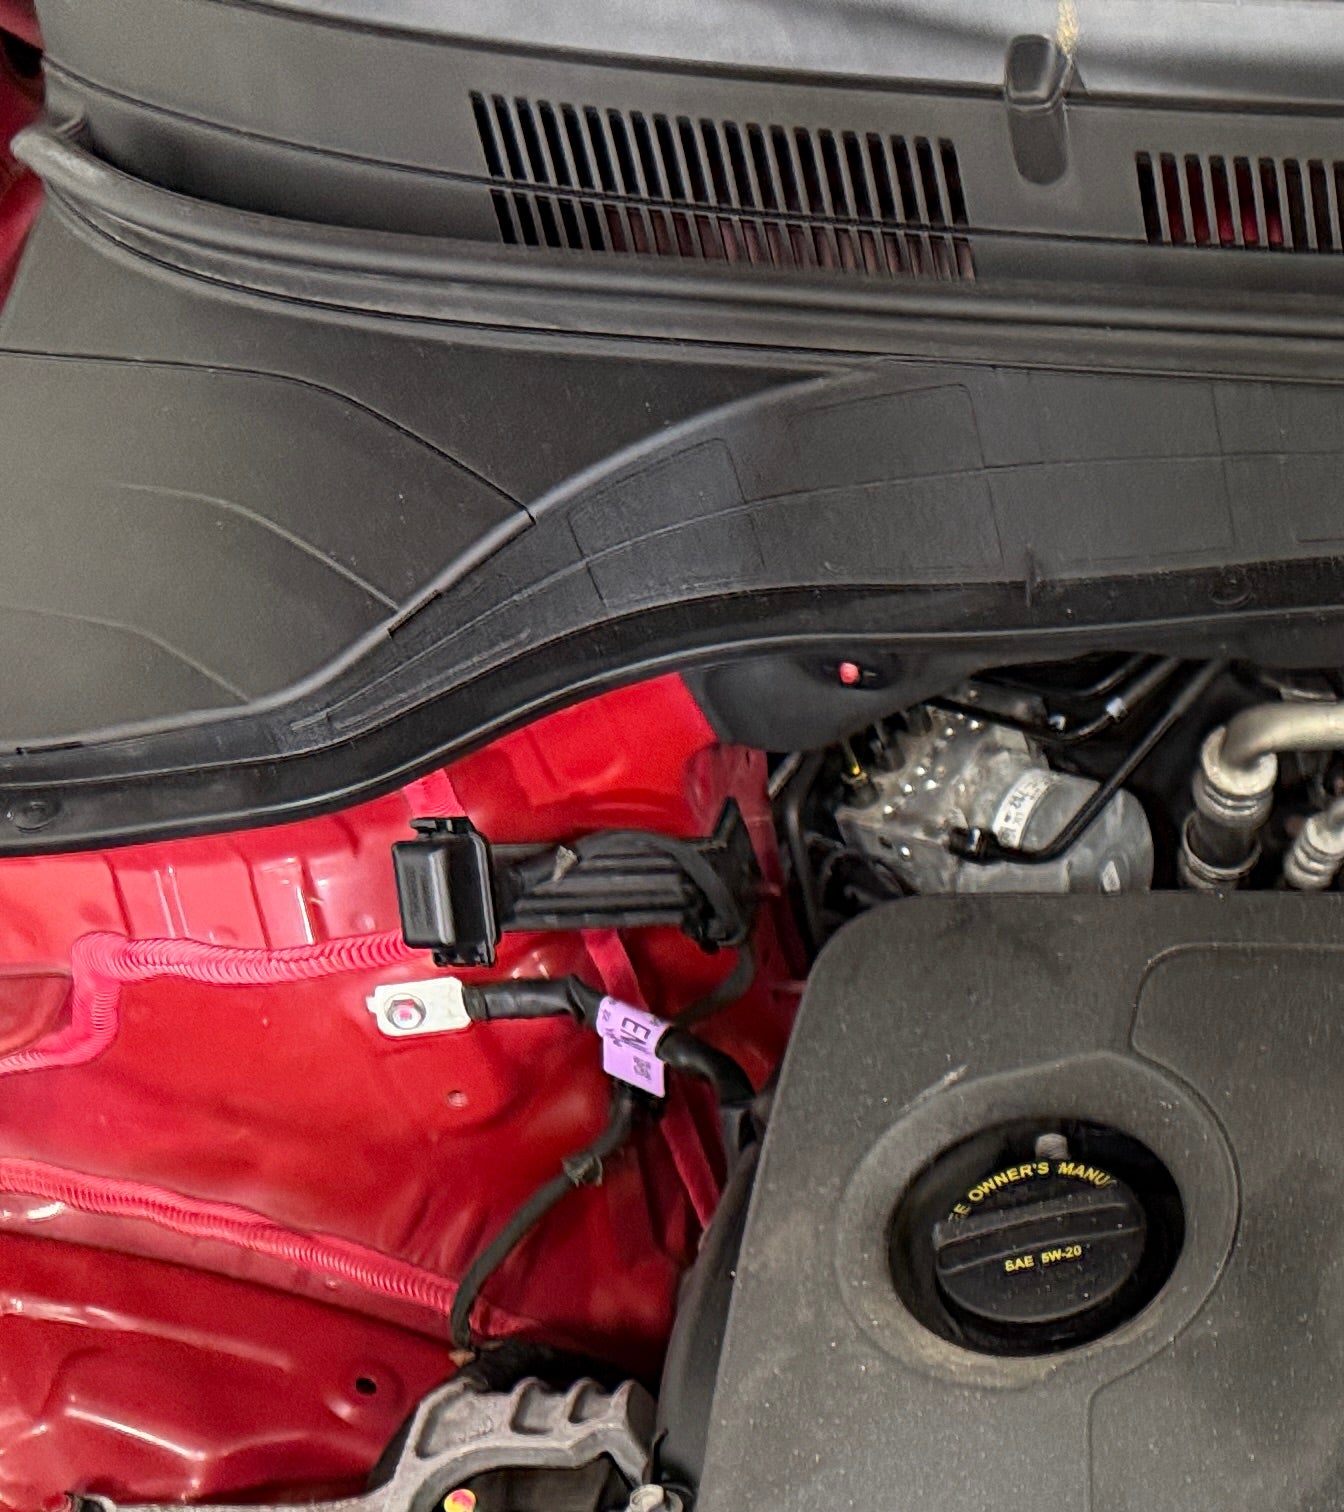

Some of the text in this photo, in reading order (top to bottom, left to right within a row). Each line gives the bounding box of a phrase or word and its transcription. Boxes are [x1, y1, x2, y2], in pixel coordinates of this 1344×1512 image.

[968, 1161, 1049, 1202] OWNER'S
[1004, 1244, 1082, 1273] SAE 5W-20
